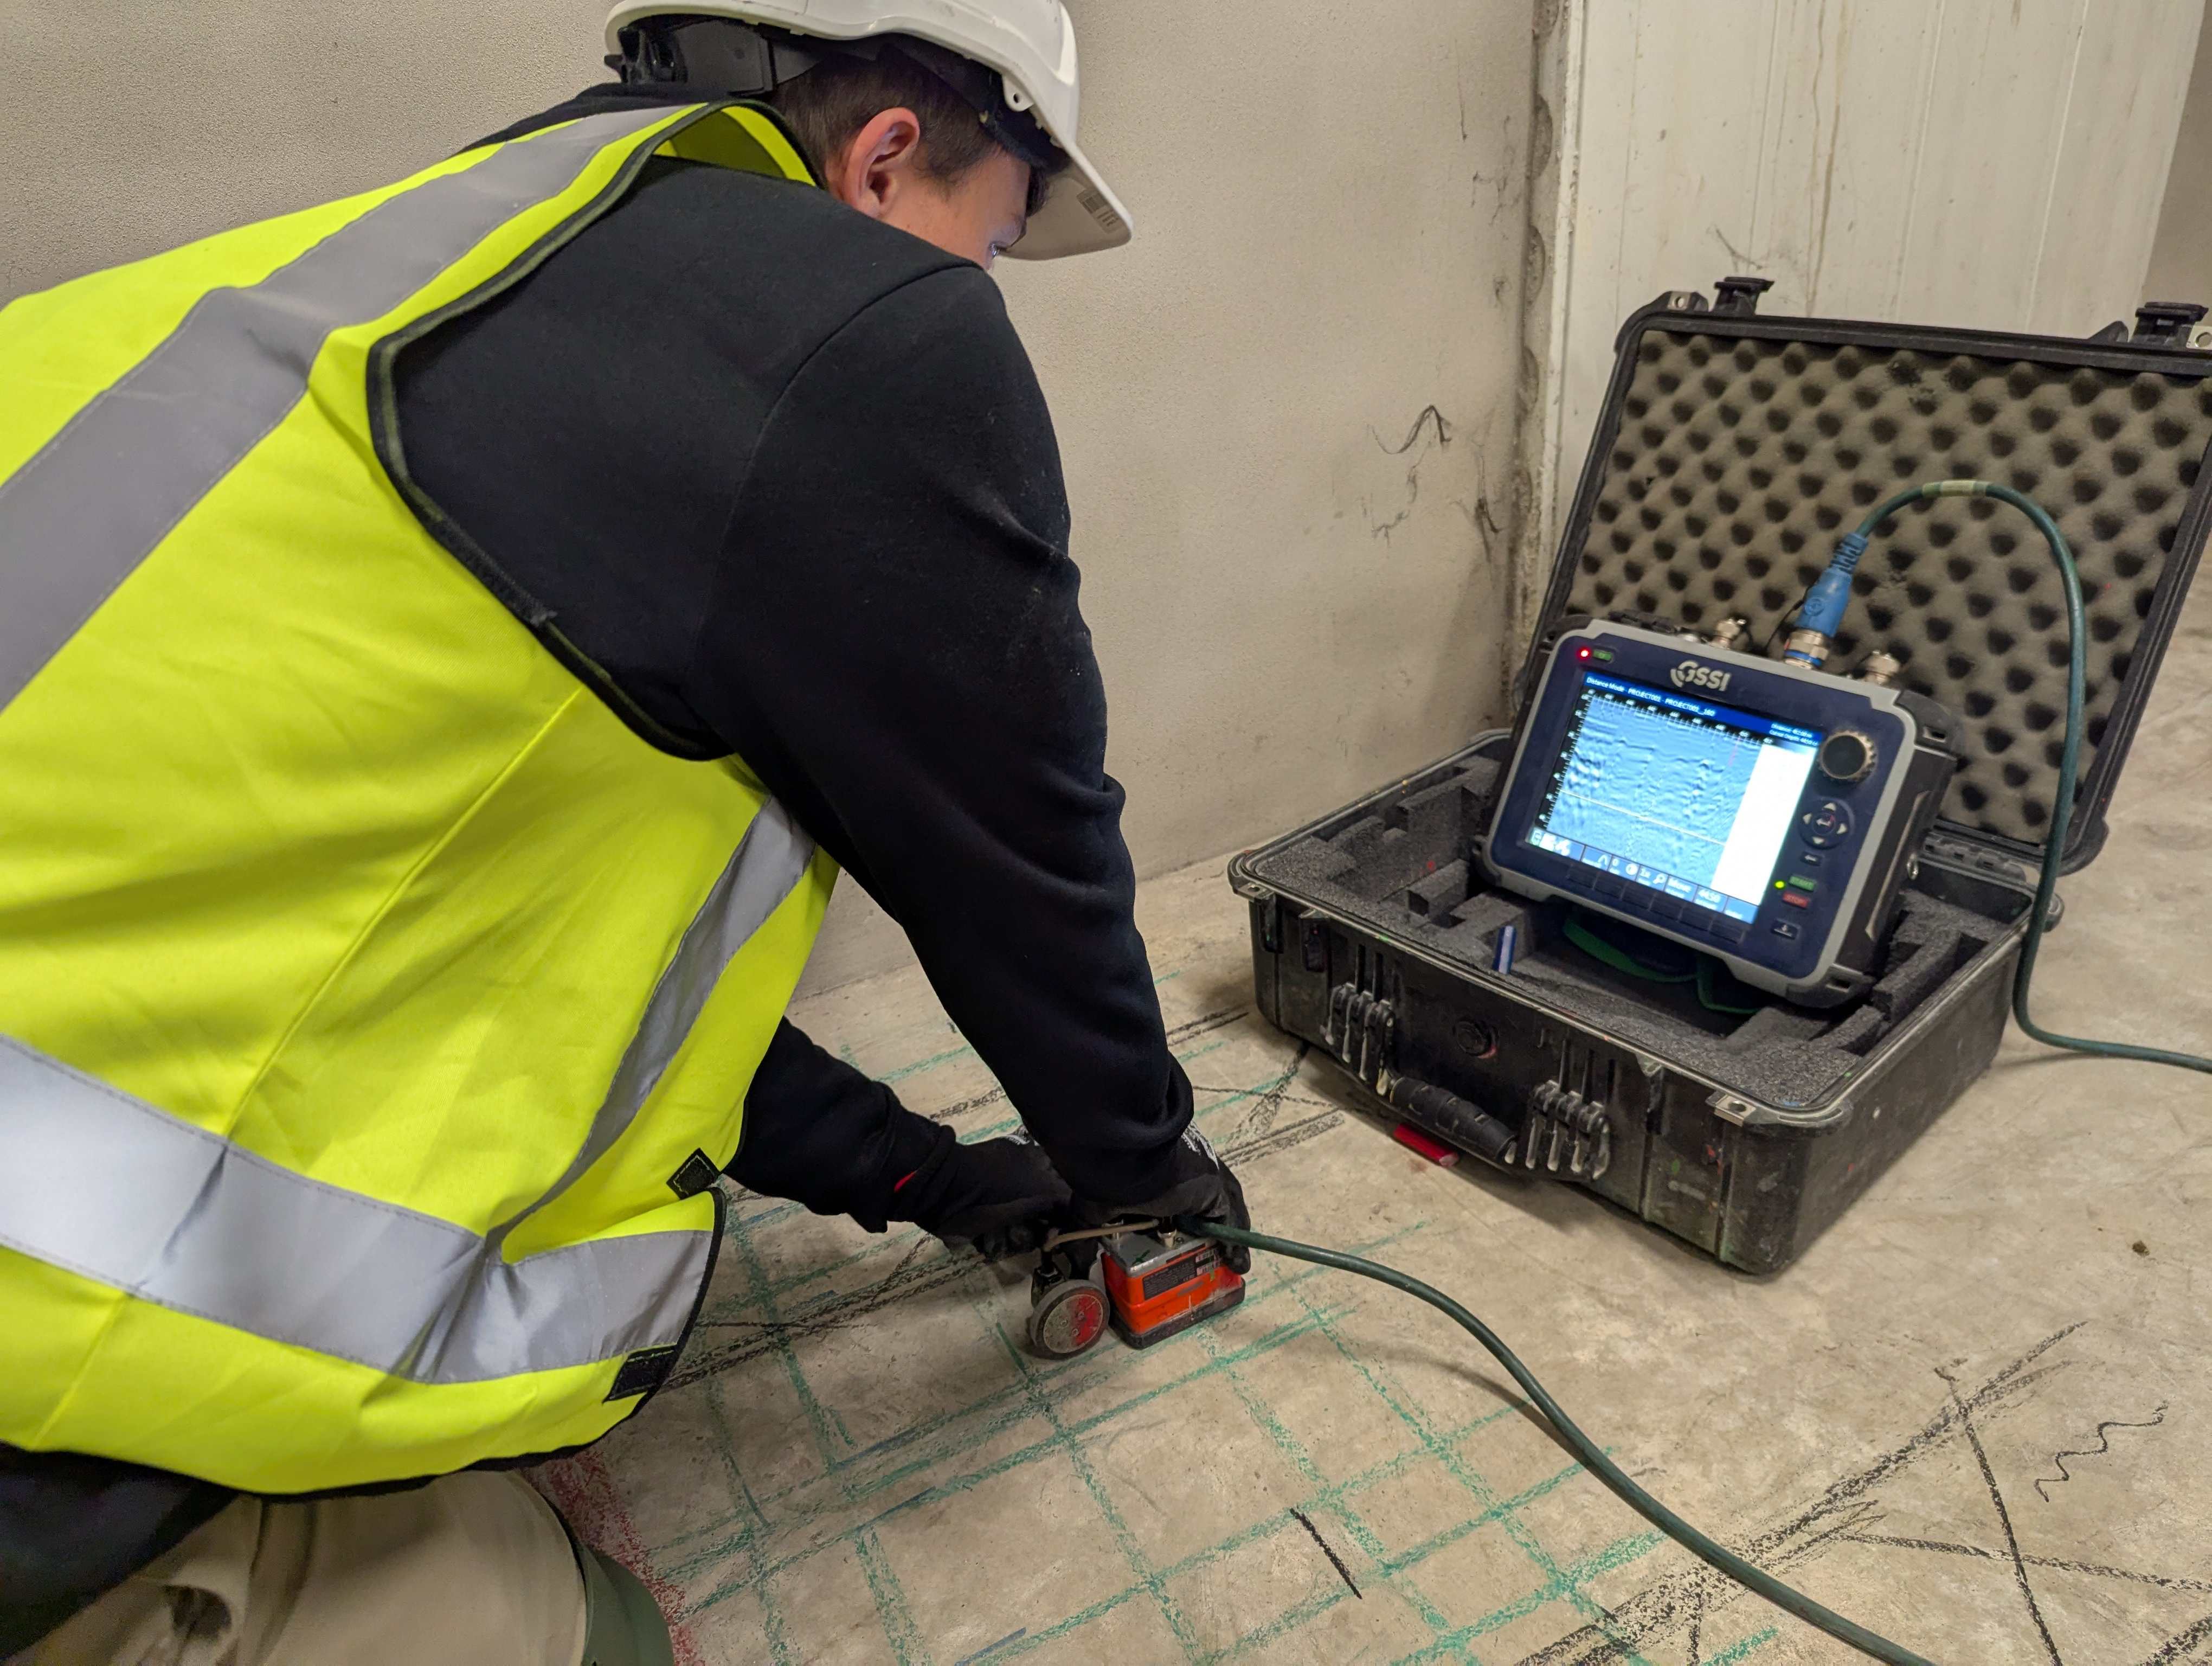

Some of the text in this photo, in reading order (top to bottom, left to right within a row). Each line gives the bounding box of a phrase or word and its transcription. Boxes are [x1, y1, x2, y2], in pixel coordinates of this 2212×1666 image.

[1586, 676, 1609, 687] Distance
[1609, 682, 1624, 693] Mode
[1628, 688, 1662, 702] PROJECT001
[1671, 661, 1731, 691] GSSI
